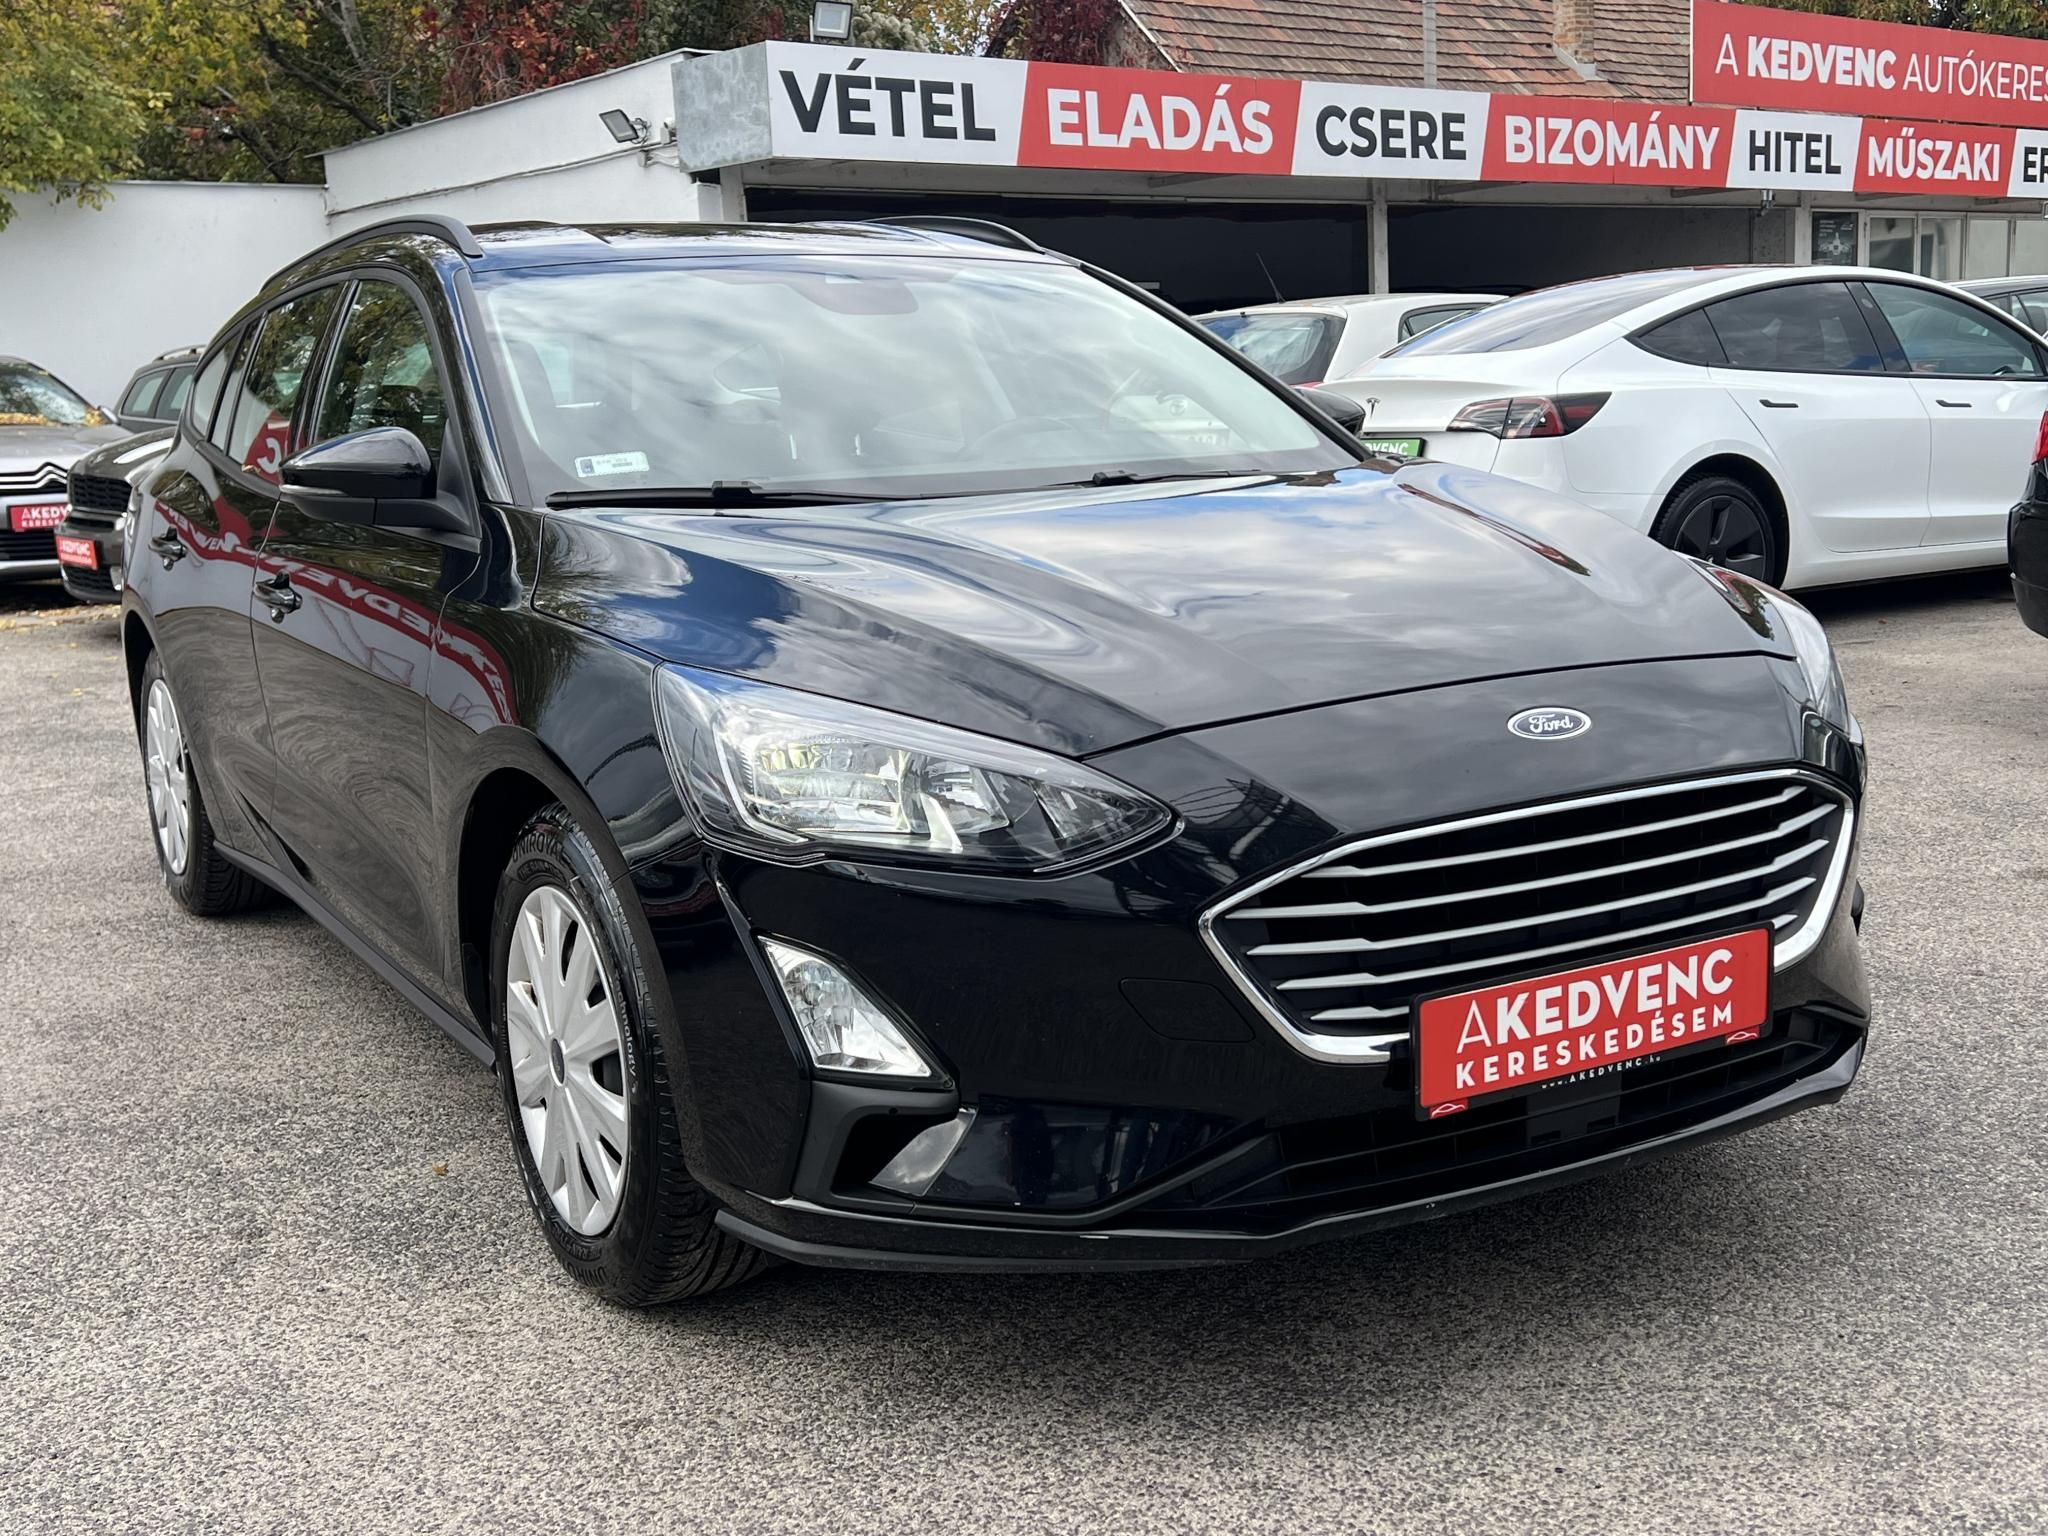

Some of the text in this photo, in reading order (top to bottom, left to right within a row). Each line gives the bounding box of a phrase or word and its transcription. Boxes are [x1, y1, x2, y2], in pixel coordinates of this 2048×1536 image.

[1715, 33, 1739, 76] A
[1747, 36, 1897, 90] KEDVENC
[779, 57, 996, 142] VÉTEL
[1046, 83, 1274, 155] ELADÁS
[1316, 105, 1467, 161] CSERE
[1504, 111, 1720, 170] BIZOMÁNY
[1749, 129, 1842, 175] HITEL
[1867, 126, 2001, 182] MŰSZAKI
[1528, 713, 1574, 733] Ford
[1456, 1001, 1733, 1089] KERESKEDÉSEM
